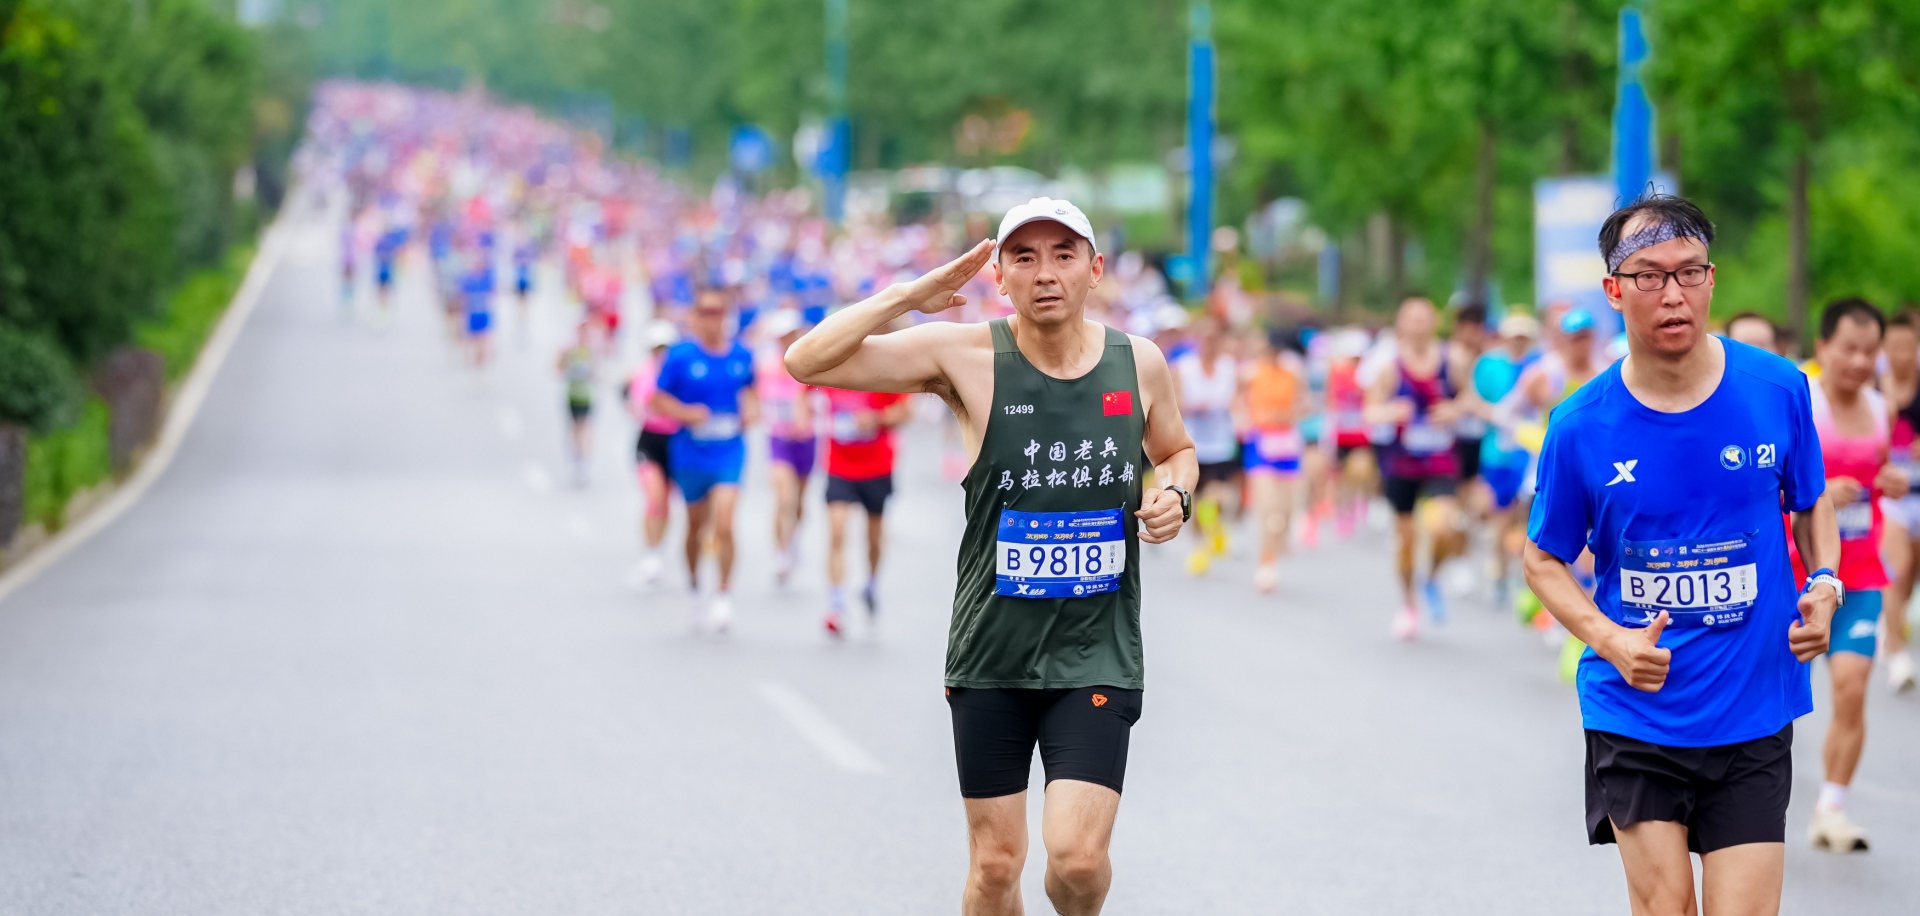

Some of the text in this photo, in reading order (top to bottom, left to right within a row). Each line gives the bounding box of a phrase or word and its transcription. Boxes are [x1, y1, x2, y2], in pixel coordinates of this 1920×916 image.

[1004, 404, 1034, 415] 12499
[1024, 436, 1118, 465] 中国老兵
[1756, 443, 1776, 464] 21
[997, 461, 1134, 491] 马拉松俱乐部
[1007, 548, 1021, 571] B
[1029, 545, 1102, 576] 9818
[1630, 576, 1646, 598] B
[1653, 571, 1732, 606] 2013
